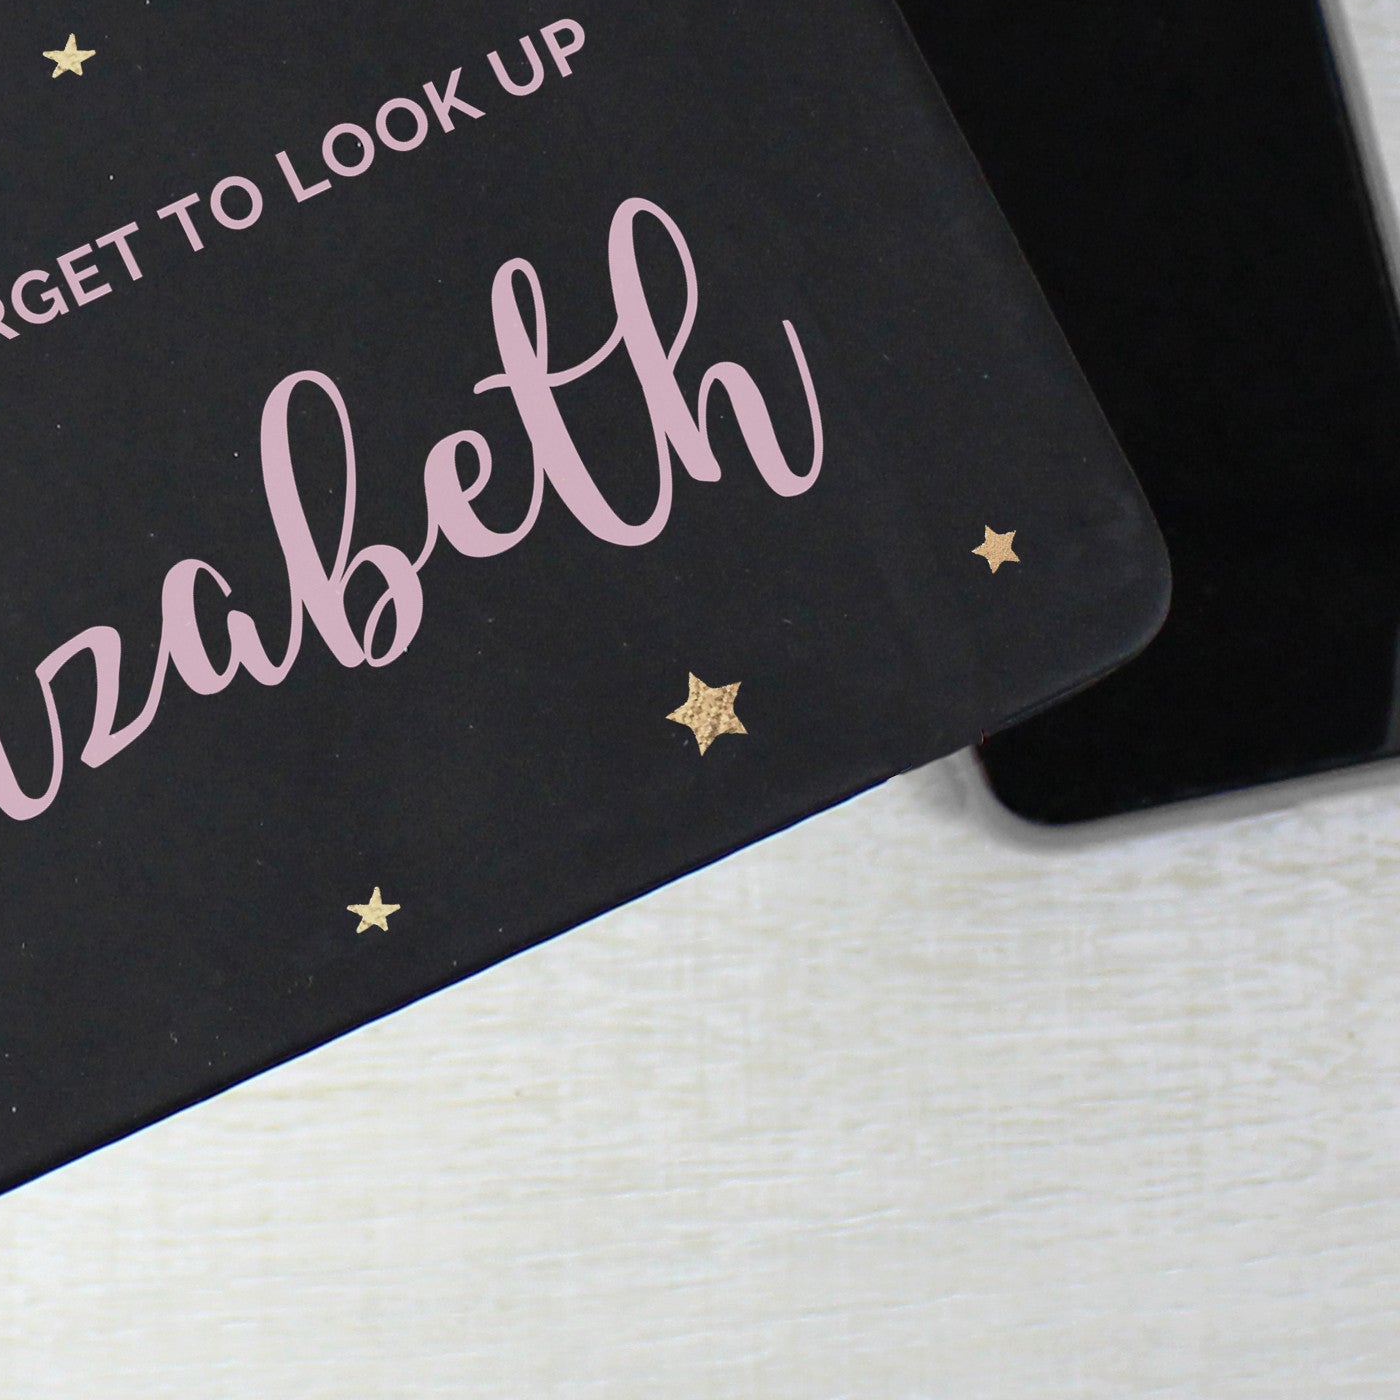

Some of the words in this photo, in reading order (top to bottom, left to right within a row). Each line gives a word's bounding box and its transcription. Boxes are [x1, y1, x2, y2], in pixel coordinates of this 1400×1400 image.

[156, 175, 264, 252] TO
[275, 67, 486, 203] LOOK
[487, 18, 586, 97] UP
